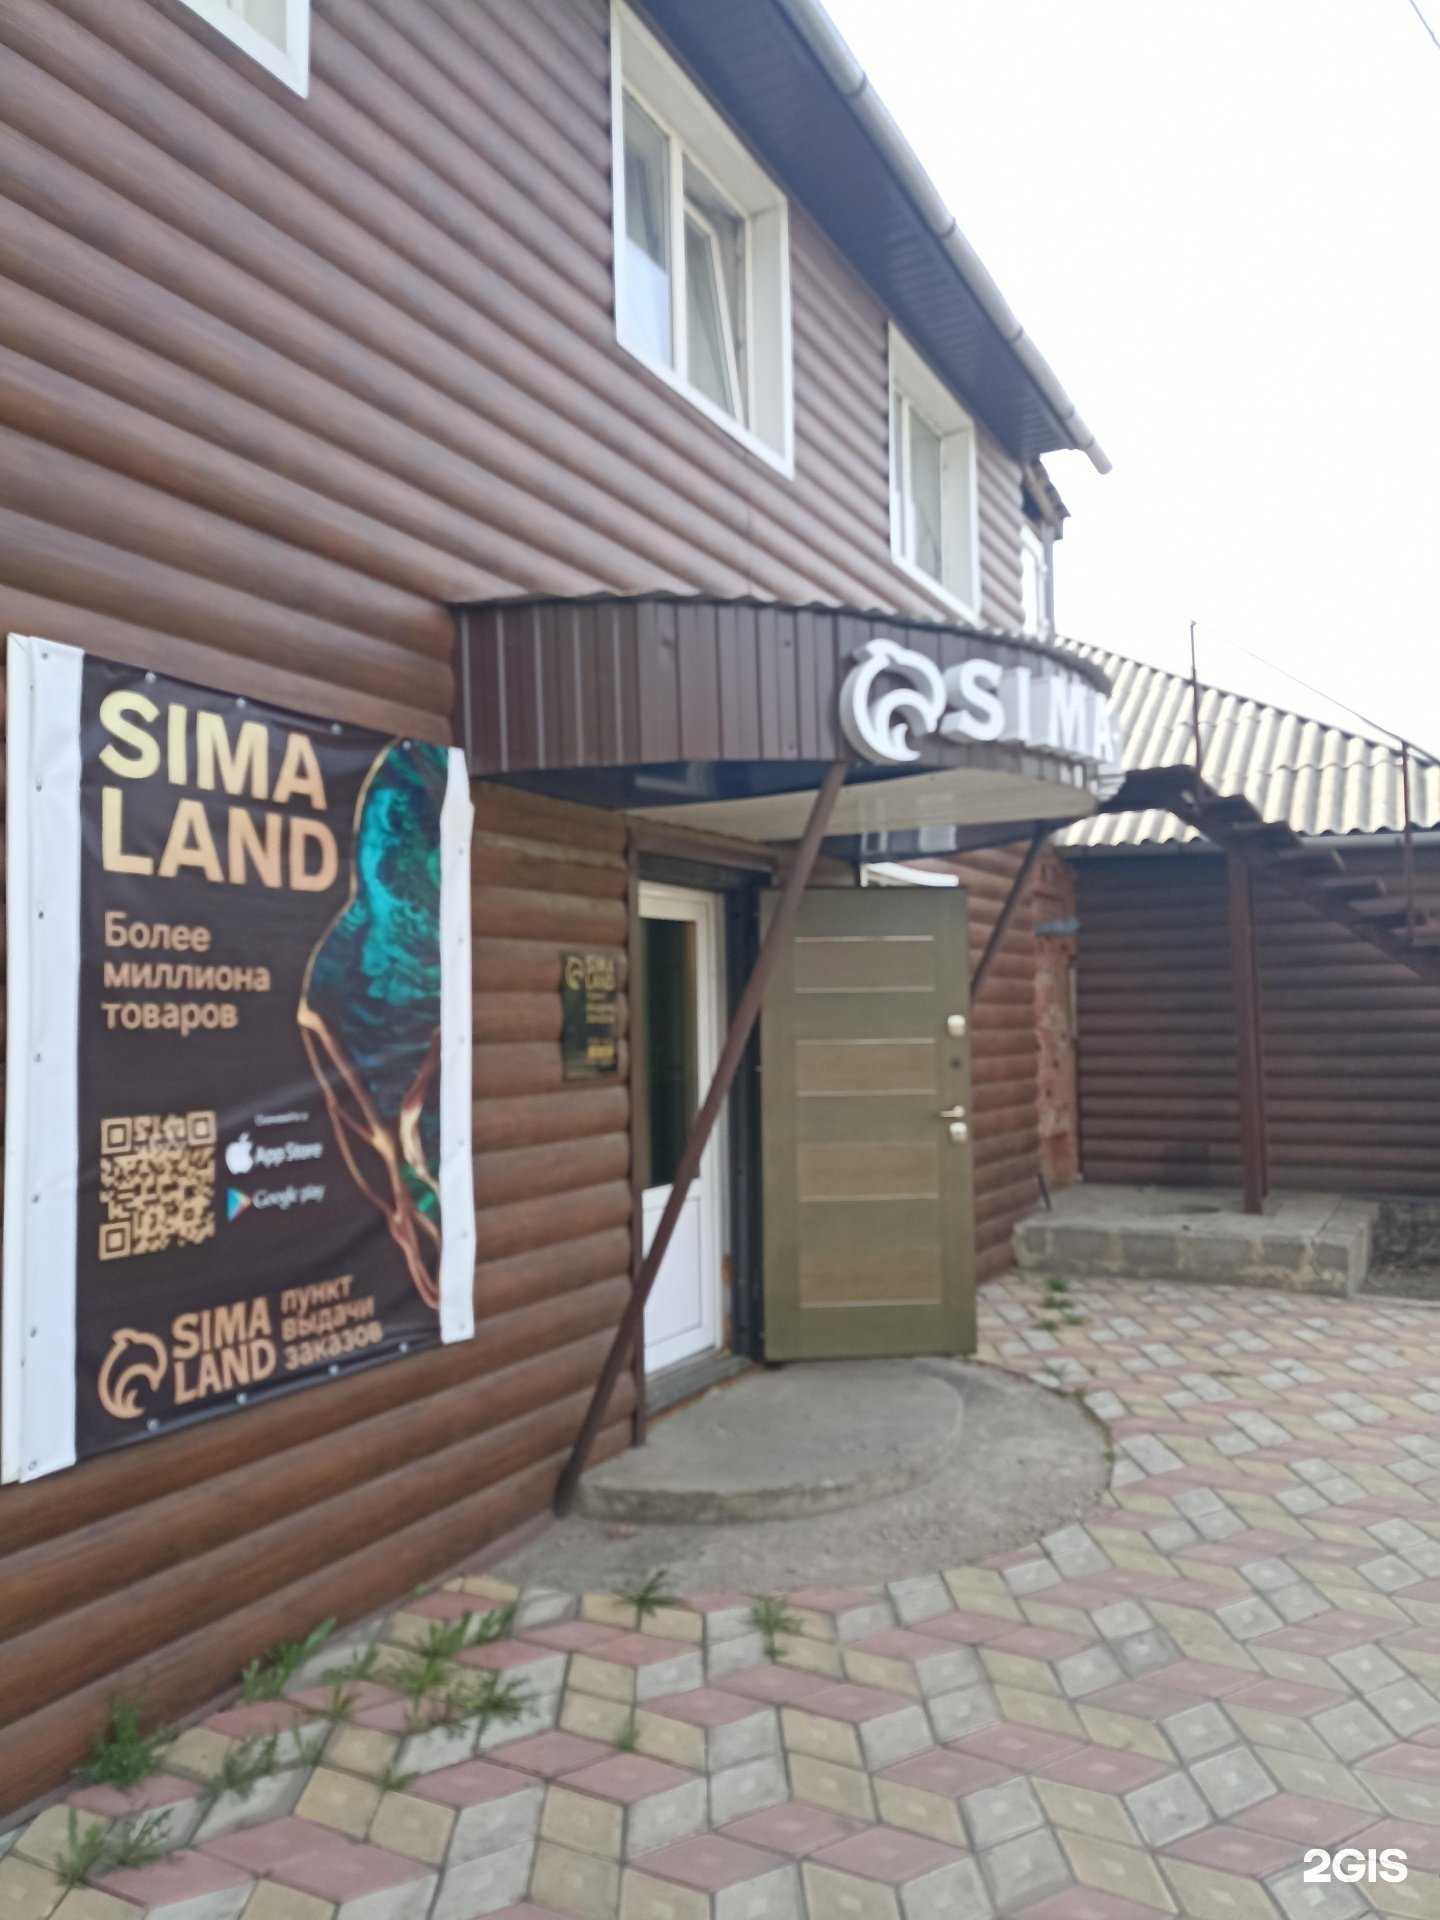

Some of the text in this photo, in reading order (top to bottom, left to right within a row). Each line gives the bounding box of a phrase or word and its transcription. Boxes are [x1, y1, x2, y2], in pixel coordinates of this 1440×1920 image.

[941, 658, 1118, 765] SIMA
[99, 689, 327, 810] SIMA
[101, 786, 339, 892] LAND
[104, 910, 212, 952] Более
[103, 961, 271, 992] миллиона
[101, 1002, 238, 1037] товаров
[281, 1274, 353, 1314] пункт
[281, 1295, 375, 1342] выдачи
[171, 1296, 272, 1359] SIMA
[284, 1320, 384, 1370] заказов
[173, 1338, 277, 1405] LAND
